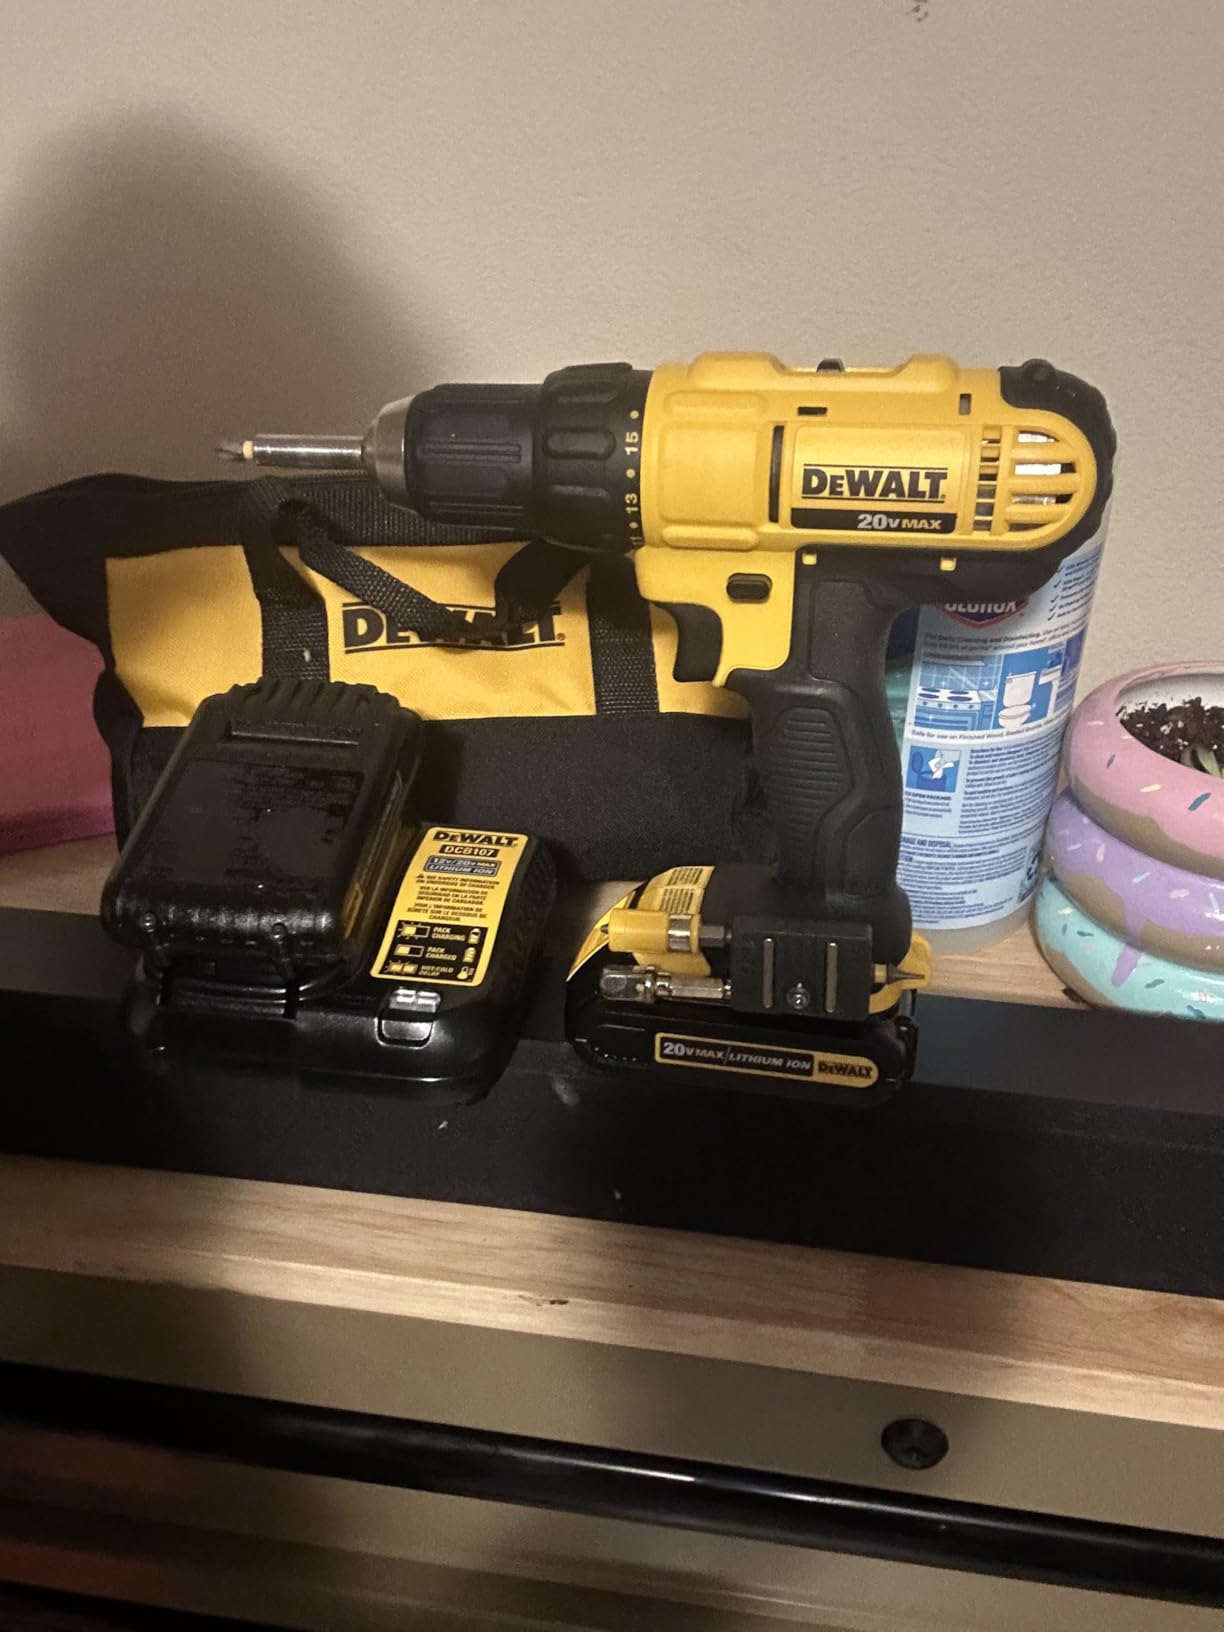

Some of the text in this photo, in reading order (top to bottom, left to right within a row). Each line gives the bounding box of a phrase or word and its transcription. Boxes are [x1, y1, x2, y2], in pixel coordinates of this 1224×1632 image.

[625, 432, 639, 456] 15
[802, 467, 948, 500] DEWALT
[625, 493, 638, 514] 13
[432, 830, 519, 847] DEWALT
[444, 846, 496, 856] DCB107
[428, 864, 472, 872] LITHIUM
[728, 1052, 782, 1067] LITHIUM
[786, 1060, 811, 1070] ION
